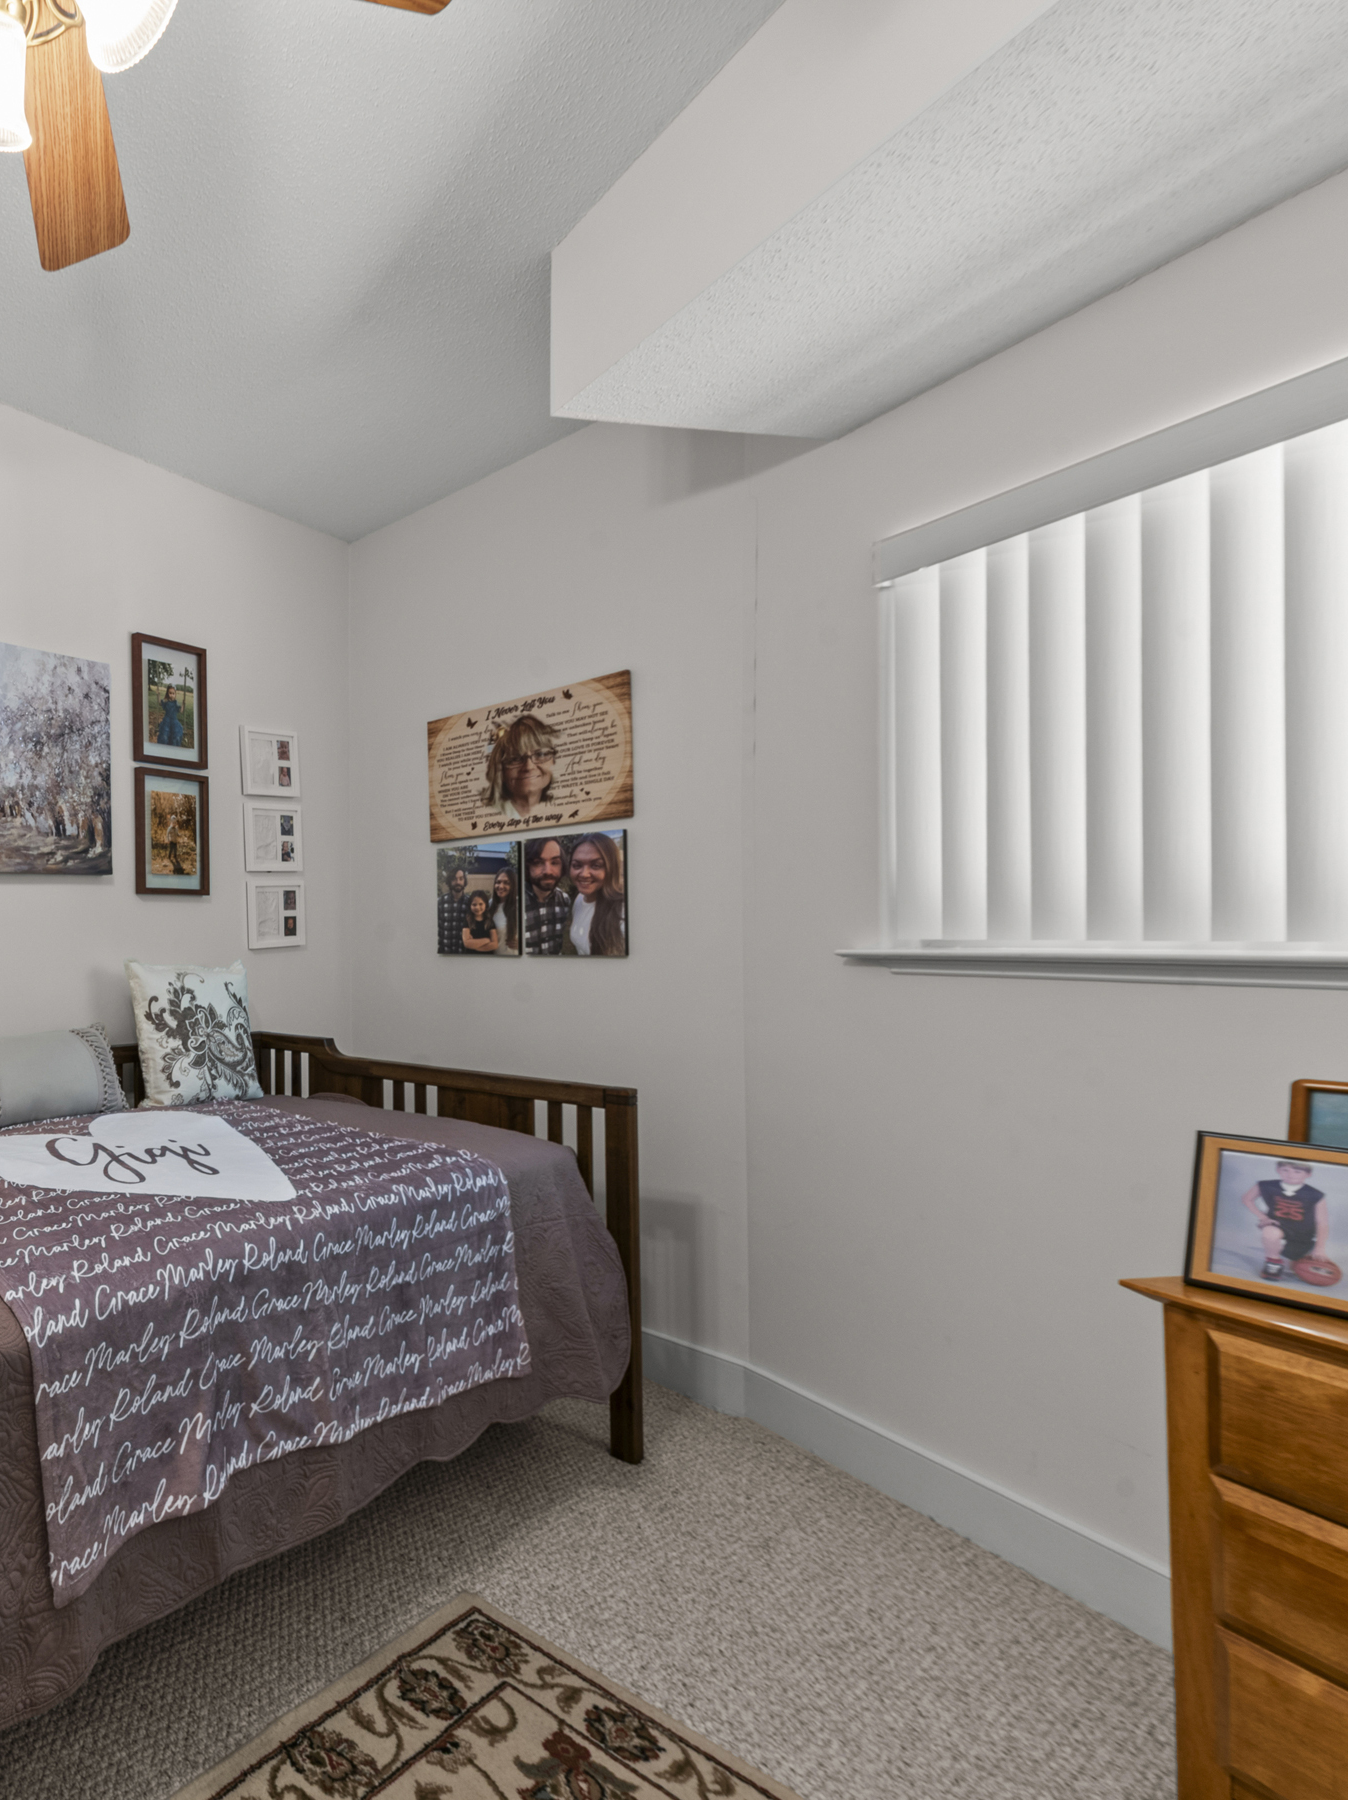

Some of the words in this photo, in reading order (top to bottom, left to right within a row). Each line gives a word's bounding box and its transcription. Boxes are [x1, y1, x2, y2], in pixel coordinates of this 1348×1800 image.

[492, 705, 519, 720] Never
[520, 700, 537, 713] Left
[537, 696, 556, 709] You
[483, 821, 505, 832] Every
[506, 817, 522, 828] step
[522, 816, 531, 827] of
[531, 814, 544, 823] the
[545, 812, 563, 823] way
[45, 1137, 220, 1184] Gigi
[304, 1152, 360, 1166] Marley
[310, 1176, 369, 1193] Roland
[368, 1166, 409, 1181] Grace
[407, 1155, 464, 1171] Marley
[333, 1156, 388, 1172] Roland
[385, 1148, 425, 1160] Grace
[13, 1222, 72, 1240] Grace
[69, 1203, 151, 1226] Marley
[67, 1193, 121, 1209] Grace
[5, 1271, 66, 1301] arley
[71, 1247, 151, 1283] Roland
[154, 1230, 210, 1256] Grace
[207, 1212, 292, 1236] Marley
[292, 1197, 355, 1225] Roland
[354, 1192, 399, 1213] Grace
[392, 1176, 452, 1206] Marley
[451, 1168, 499, 1196] Roland
[16, 1235, 106, 1263] Marley
[110, 1213, 181, 1240] Roland
[184, 1200, 240, 1219] Grace
[24, 1299, 89, 1348] oland
[95, 1285, 160, 1320] Grace
[157, 1248, 239, 1300] Marley
[242, 1236, 309, 1275] Roland
[313, 1232, 354, 1263] Grace
[355, 1218, 410, 1250] Marley
[412, 1209, 459, 1243] Roland
[461, 1204, 497, 1230] Grace
[36, 1370, 82, 1405] race
[85, 1322, 176, 1387] Marley
[180, 1296, 248, 1348] Roland
[252, 1288, 301, 1320] Grace
[303, 1270, 363, 1310] Marley
[365, 1260, 418, 1298] Roland
[420, 1252, 455, 1280] Grace
[455, 1234, 501, 1272] Marley
[41, 1407, 105, 1461] arley
[110, 1368, 193, 1431] Roland
[199, 1352, 247, 1390] Grace
[249, 1325, 324, 1371] Marley
[378, 1305, 417, 1335] Grace
[419, 1285, 468, 1325] Marley
[470, 1271, 511, 1305] Roland
[46, 1462, 107, 1524] oland
[112, 1441, 176, 1483] Grace
[249, 1374, 324, 1418] Roland
[364, 1341, 424, 1386] Marley
[427, 1325, 470, 1368] Roland
[472, 1317, 503, 1347] Grace
[103, 1478, 197, 1557] Marley
[257, 1431, 311, 1463] Grace
[467, 1348, 516, 1388] Marley
